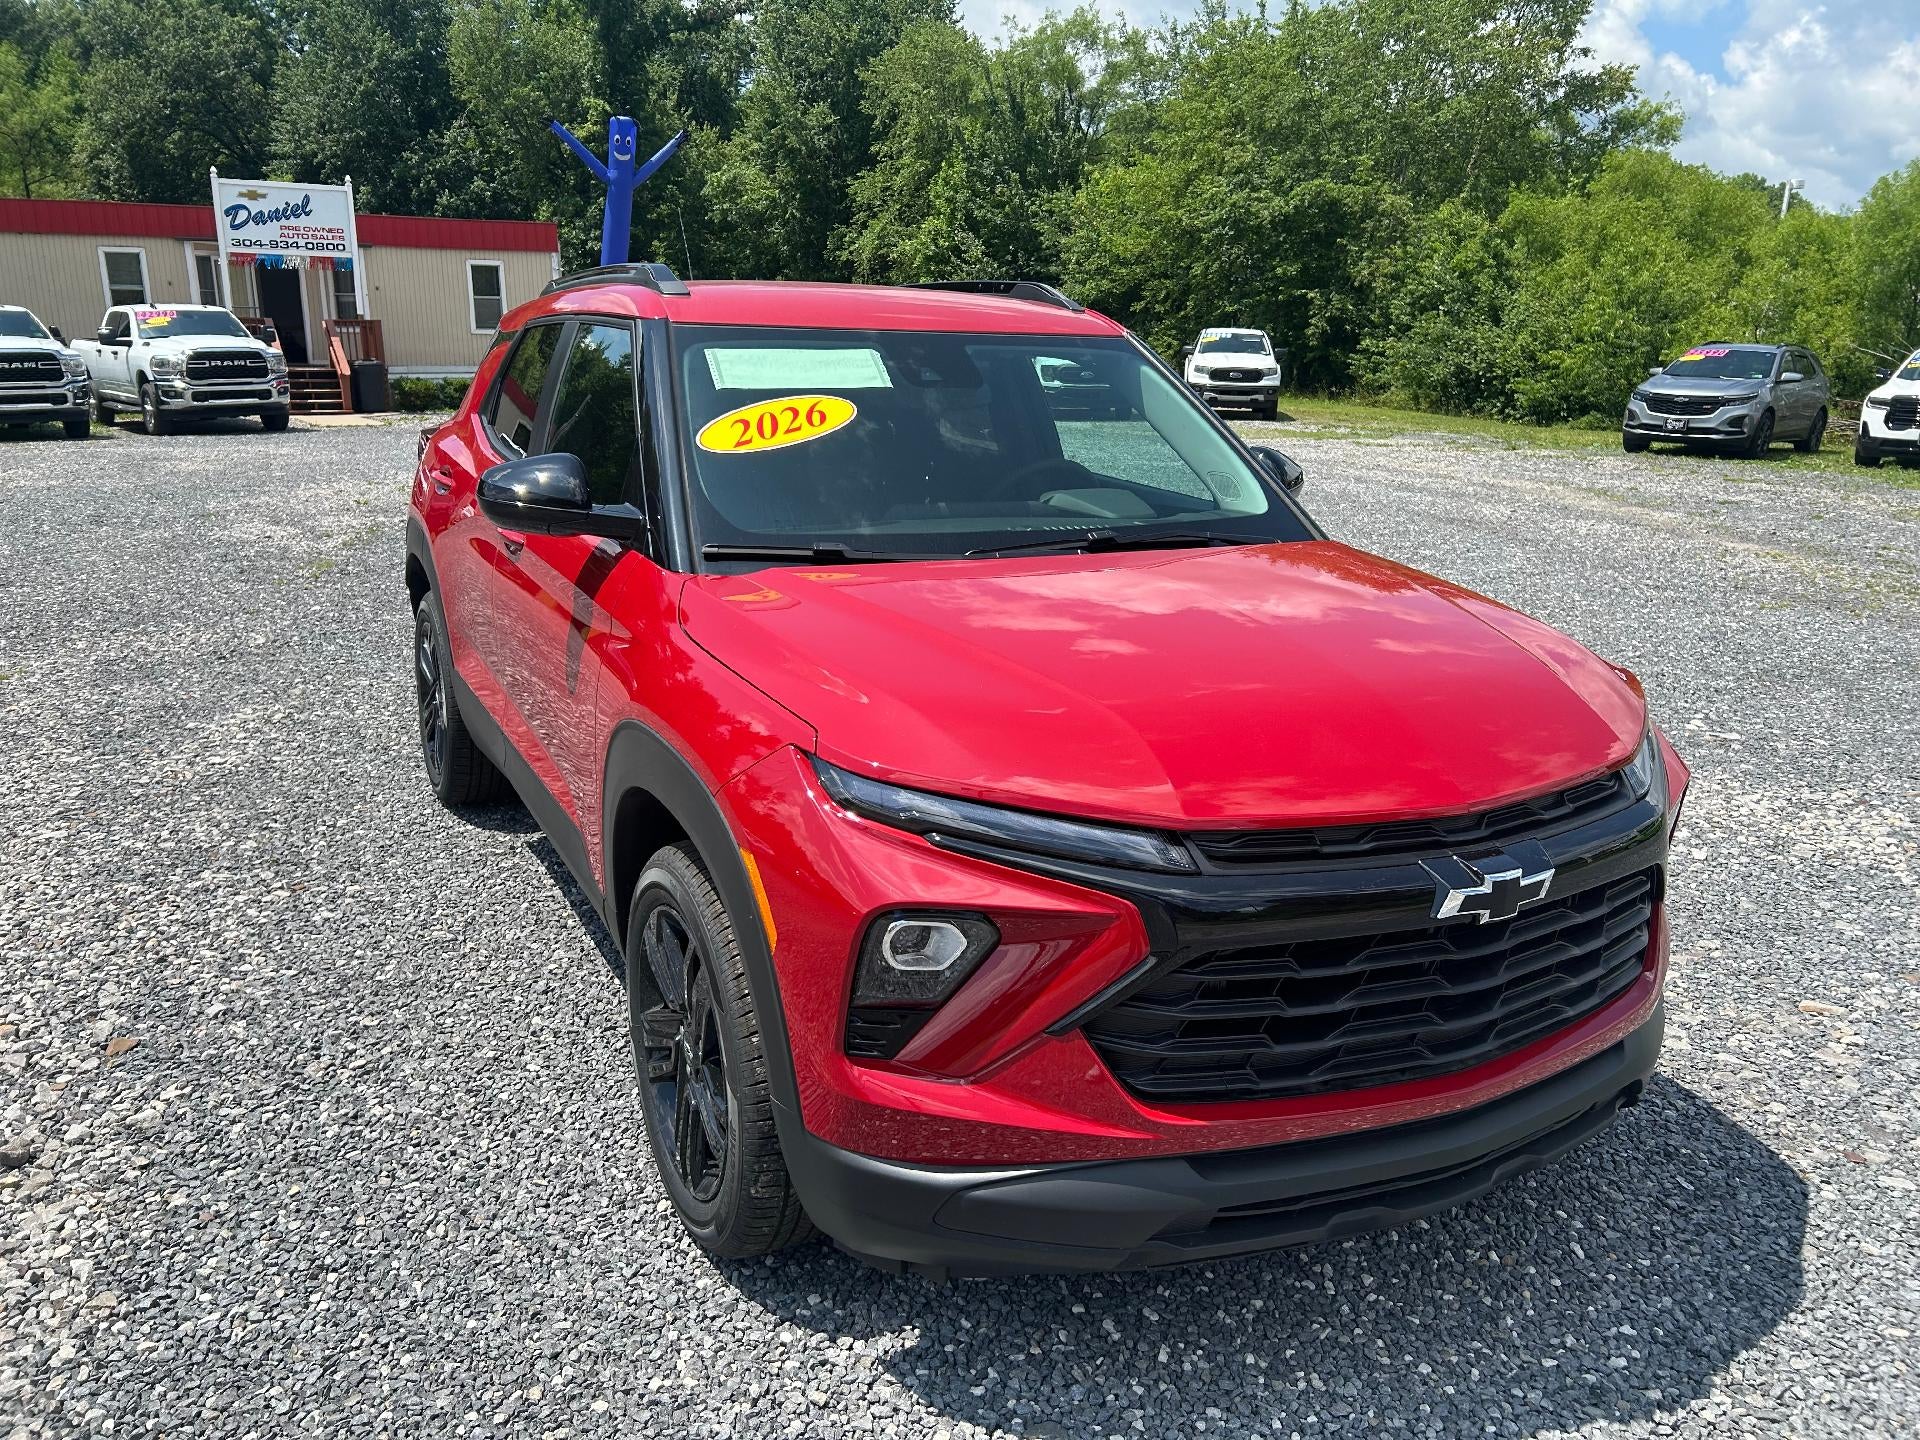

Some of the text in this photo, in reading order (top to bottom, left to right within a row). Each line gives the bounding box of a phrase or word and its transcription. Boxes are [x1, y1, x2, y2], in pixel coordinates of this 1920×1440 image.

[224, 193, 313, 230] Daniel
[303, 226, 344, 234] OWNED
[279, 232, 345, 241] AUTO SALES
[231, 238, 346, 251] 304-934-0800
[0, 361, 36, 369] RAM
[730, 400, 827, 449] 2026
